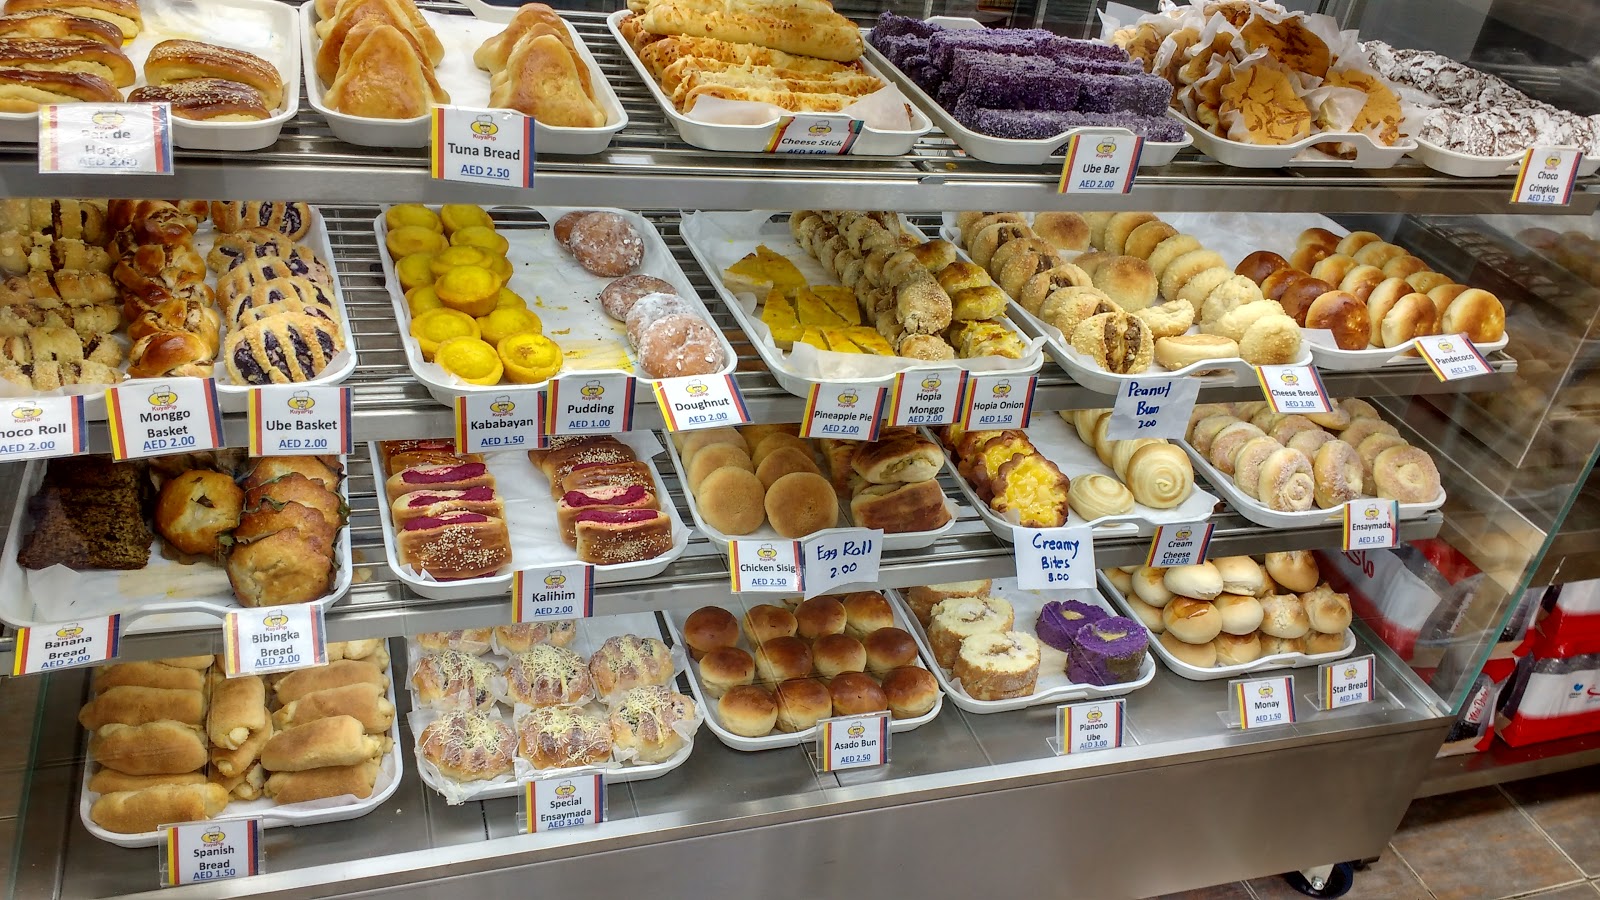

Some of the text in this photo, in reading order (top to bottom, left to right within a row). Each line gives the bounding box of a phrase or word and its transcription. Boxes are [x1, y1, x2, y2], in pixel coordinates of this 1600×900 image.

[113, 129, 131, 139] de
[781, 138, 843, 148] Cheese Stick
[448, 142, 520, 161] Tuna Bread
[461, 164, 511, 178] AED 2.50
[1082, 163, 1120, 174] Ube Bar
[1538, 170, 1558, 180] Choco
[1079, 180, 1115, 189] AED 2.00
[1529, 183, 1560, 194] Cringkles
[1528, 194, 1555, 203] AED 1.50
[1436, 354, 1474, 366] Pandecoco
[1451, 364, 1477, 375] AED 2.00
[1128, 381, 1172, 397] Peanut
[1272, 388, 1319, 397] Cheese Bread
[916, 393, 942, 403] Hopia
[567, 403, 615, 415] Pudding
[675, 397, 730, 412] Doughnut
[974, 401, 1024, 411] Hopia Onion
[1136, 401, 1160, 416] Bun
[140, 409, 191, 424] Monggo
[813, 410, 872, 422] Pineapple Pie
[909, 406, 945, 417] Monggo
[569, 419, 610, 428] AED 1.00
[688, 412, 728, 424] AED 2.00
[908, 414, 943, 423] AED 2.00
[979, 414, 1013, 423] AED 1.50
[38, 423, 67, 436] Roll
[266, 419, 337, 431] Ube Basket
[471, 418, 534, 431] Kababayan
[822, 424, 859, 433] AED 2.00
[147, 425, 188, 439] Basket
[144, 435, 195, 450] AED 2.00
[279, 438, 327, 448] AED 2.00
[481, 435, 525, 446] AED 1.50
[0, 441, 55, 453] AED 2.00
[1352, 521, 1391, 531] Ensaymada
[816, 540, 872, 561] Egg Roll
[1032, 533, 1079, 560] Creamy
[1163, 551, 1190, 559] Cheese
[740, 564, 796, 573] Chicken Sisig
[1041, 555, 1070, 570] Bites
[830, 562, 857, 579] 2.00
[532, 591, 575, 603] Kalihim
[535, 605, 573, 615] AED 2.00
[45, 636, 92, 649] Banana
[252, 630, 300, 644] Bibingka
[49, 647, 86, 660] Bread
[260, 646, 294, 657] Bread
[42, 654, 90, 669] AED 2.00
[255, 655, 300, 667] AED 2.00
[1332, 680, 1368, 695] Star Bread
[1254, 701, 1280, 710] Monay
[1080, 722, 1108, 731] Pianono
[834, 739, 877, 751] Asado Bun
[1094, 740, 1107, 748] 3.00
[840, 754, 871, 763] AED 2.50
[550, 797, 582, 810] Special
[541, 809, 592, 822] Ensaymada
[548, 817, 584, 829] AED 3.00
[193, 845, 235, 858] Spanish
[199, 859, 230, 871] Bread
[193, 868, 235, 880] AED 1.50
